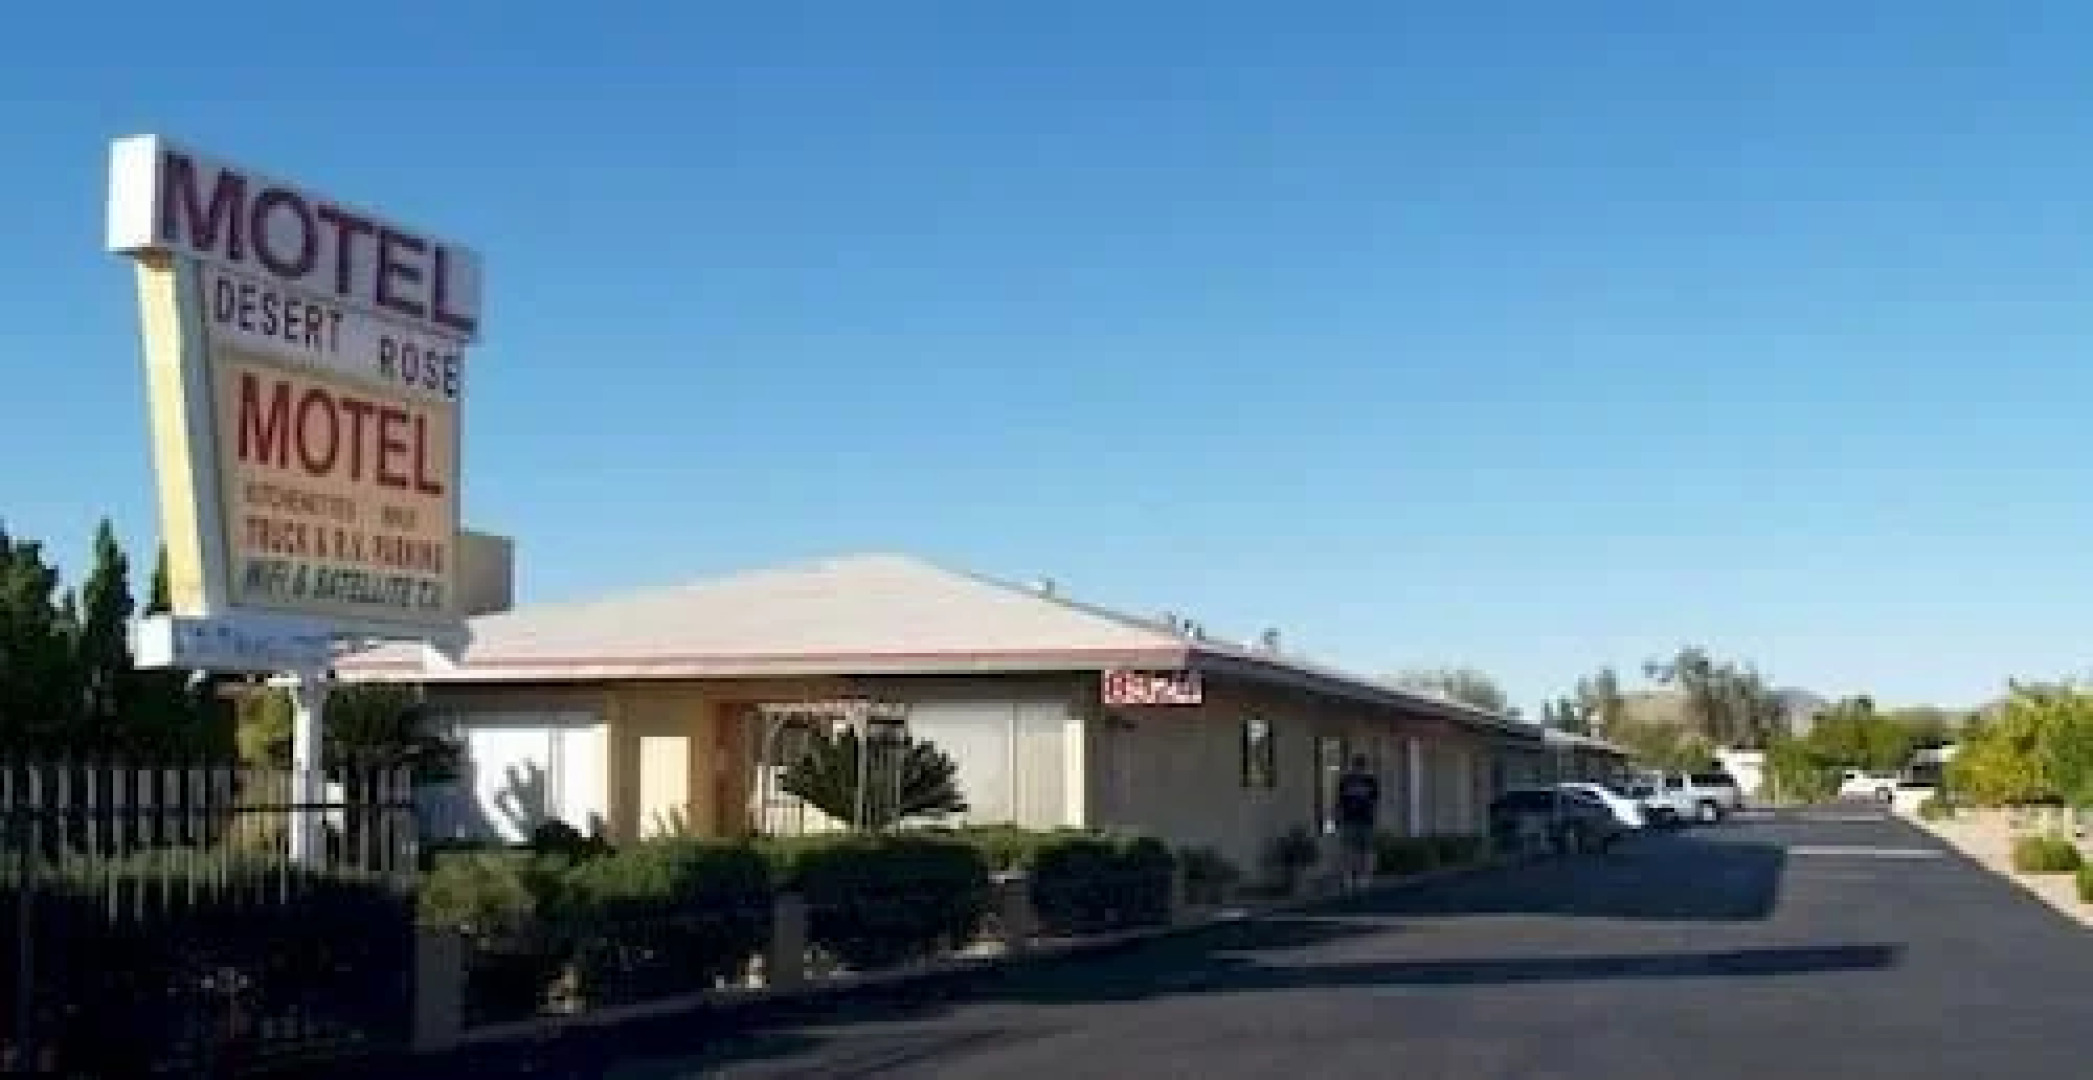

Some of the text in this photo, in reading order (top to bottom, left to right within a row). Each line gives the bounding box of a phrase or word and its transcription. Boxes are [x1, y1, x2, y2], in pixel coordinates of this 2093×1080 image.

[162, 150, 478, 332] MOTEL
[216, 276, 462, 399] DESERT ROSE
[238, 371, 444, 495] MOTEL
[246, 517, 306, 555] TRUCK
